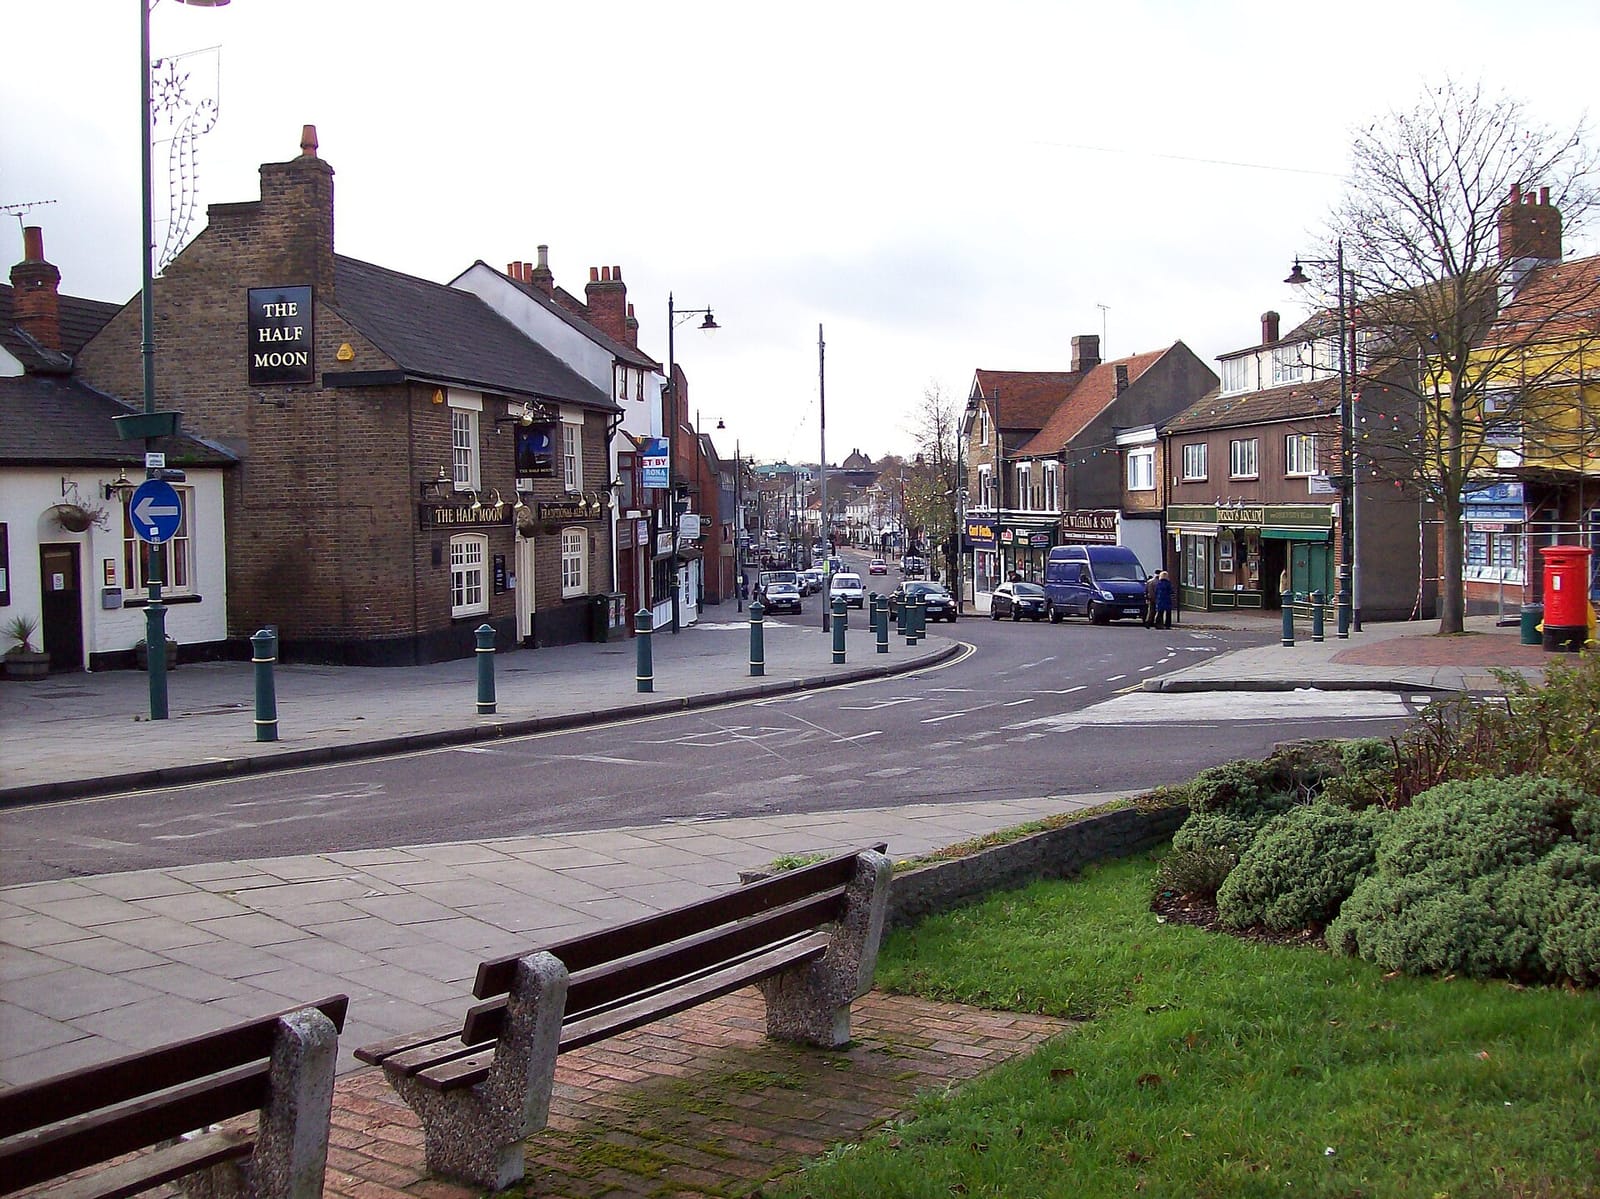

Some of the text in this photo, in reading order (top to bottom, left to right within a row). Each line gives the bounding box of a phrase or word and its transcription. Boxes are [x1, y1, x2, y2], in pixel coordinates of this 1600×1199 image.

[263, 303, 298, 318] THE
[258, 326, 304, 342] HALF
[254, 351, 308, 368] MOON
[655, 458, 666, 466] BY
[435, 507, 503, 524] THE HALF MOON
[1093, 516, 1099, 529] &
[1100, 516, 1114, 529] SON
